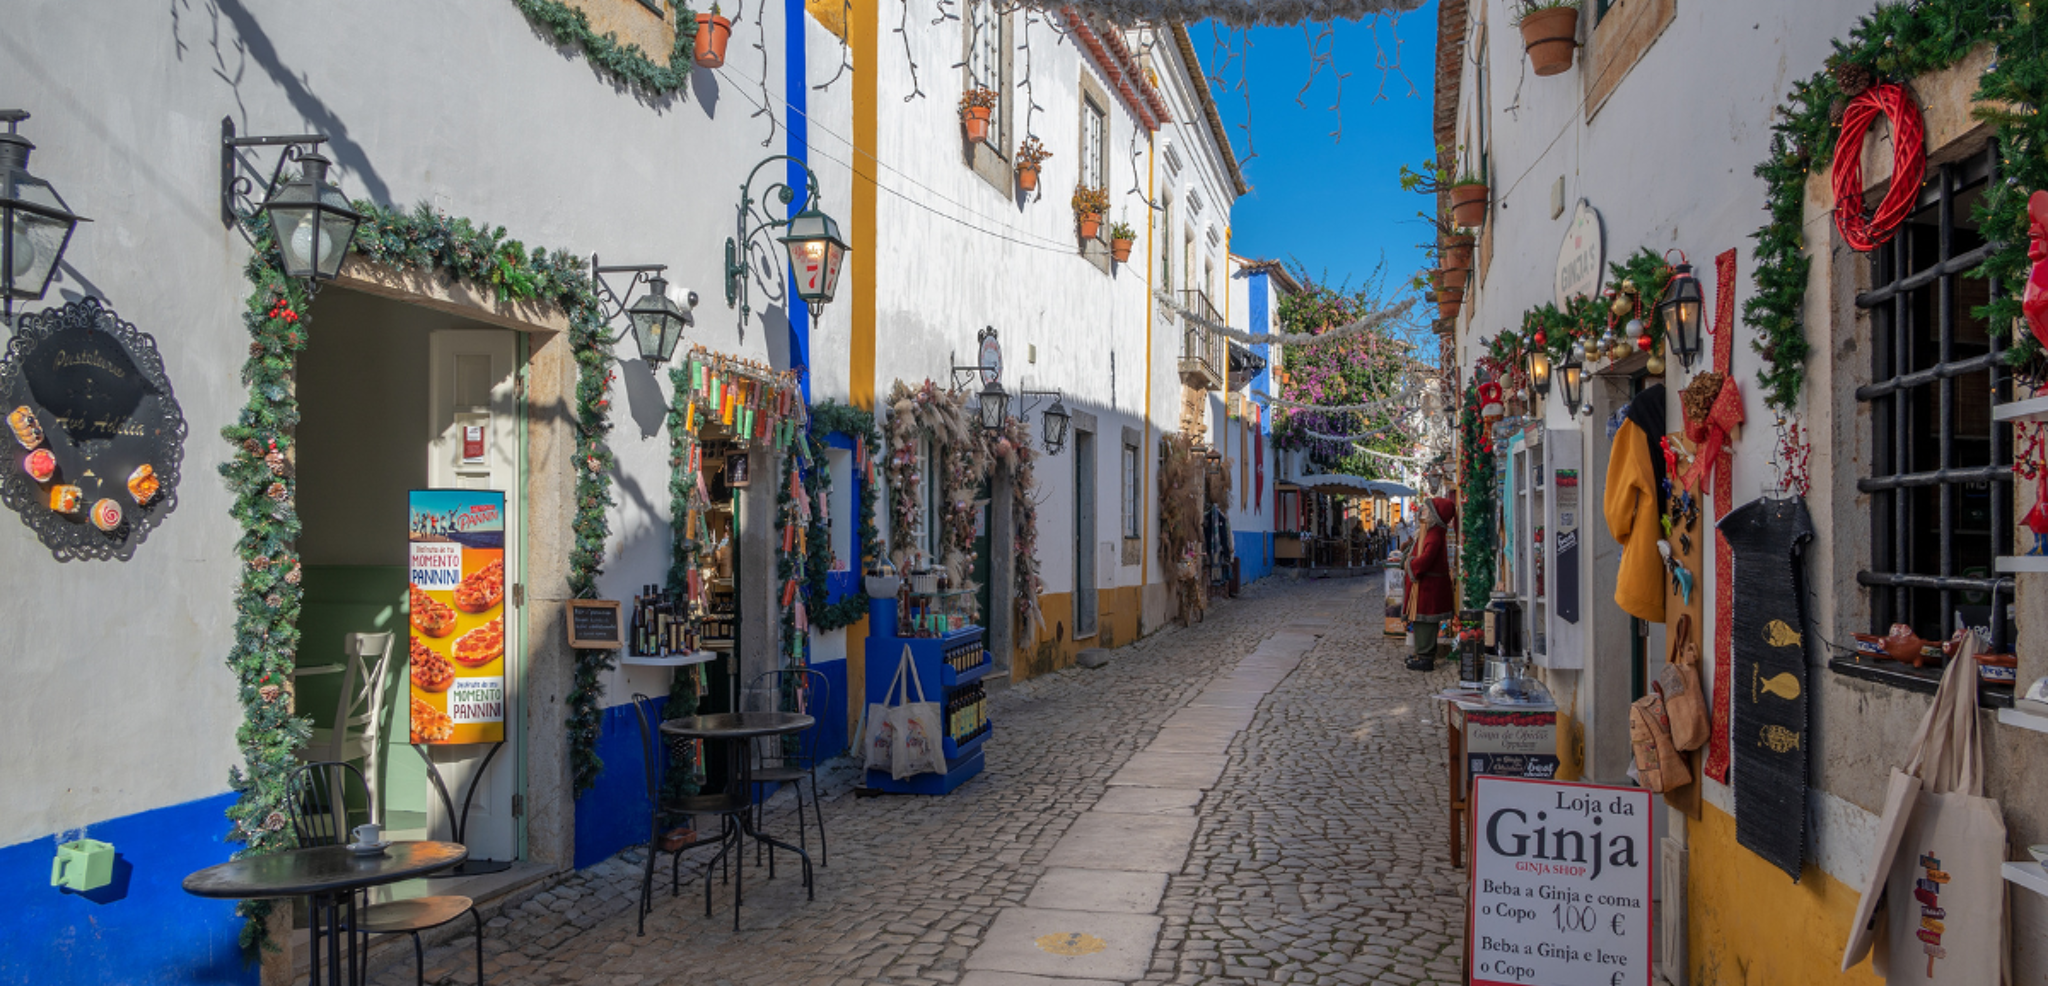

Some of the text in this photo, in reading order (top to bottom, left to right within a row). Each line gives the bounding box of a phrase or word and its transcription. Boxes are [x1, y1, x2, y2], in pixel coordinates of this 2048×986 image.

[806, 264, 818, 289] 7
[412, 555, 460, 567] MOMENTO
[412, 569, 460, 586] PANNINI
[453, 689, 502, 702] MOMENTO
[453, 702, 501, 719] PANNINI
[1555, 791, 1634, 817] Loja da
[1486, 808, 1639, 881] Ginja
[1515, 861, 1586, 877] GINJA SHOP
[1483, 878, 1640, 908] Beba a Ginja e coma
[1482, 902, 1625, 936] o Copo 1,00 €
[1481, 936, 1627, 966] Beba a Ginja e leve
[1480, 960, 1625, 986] o Copo €
